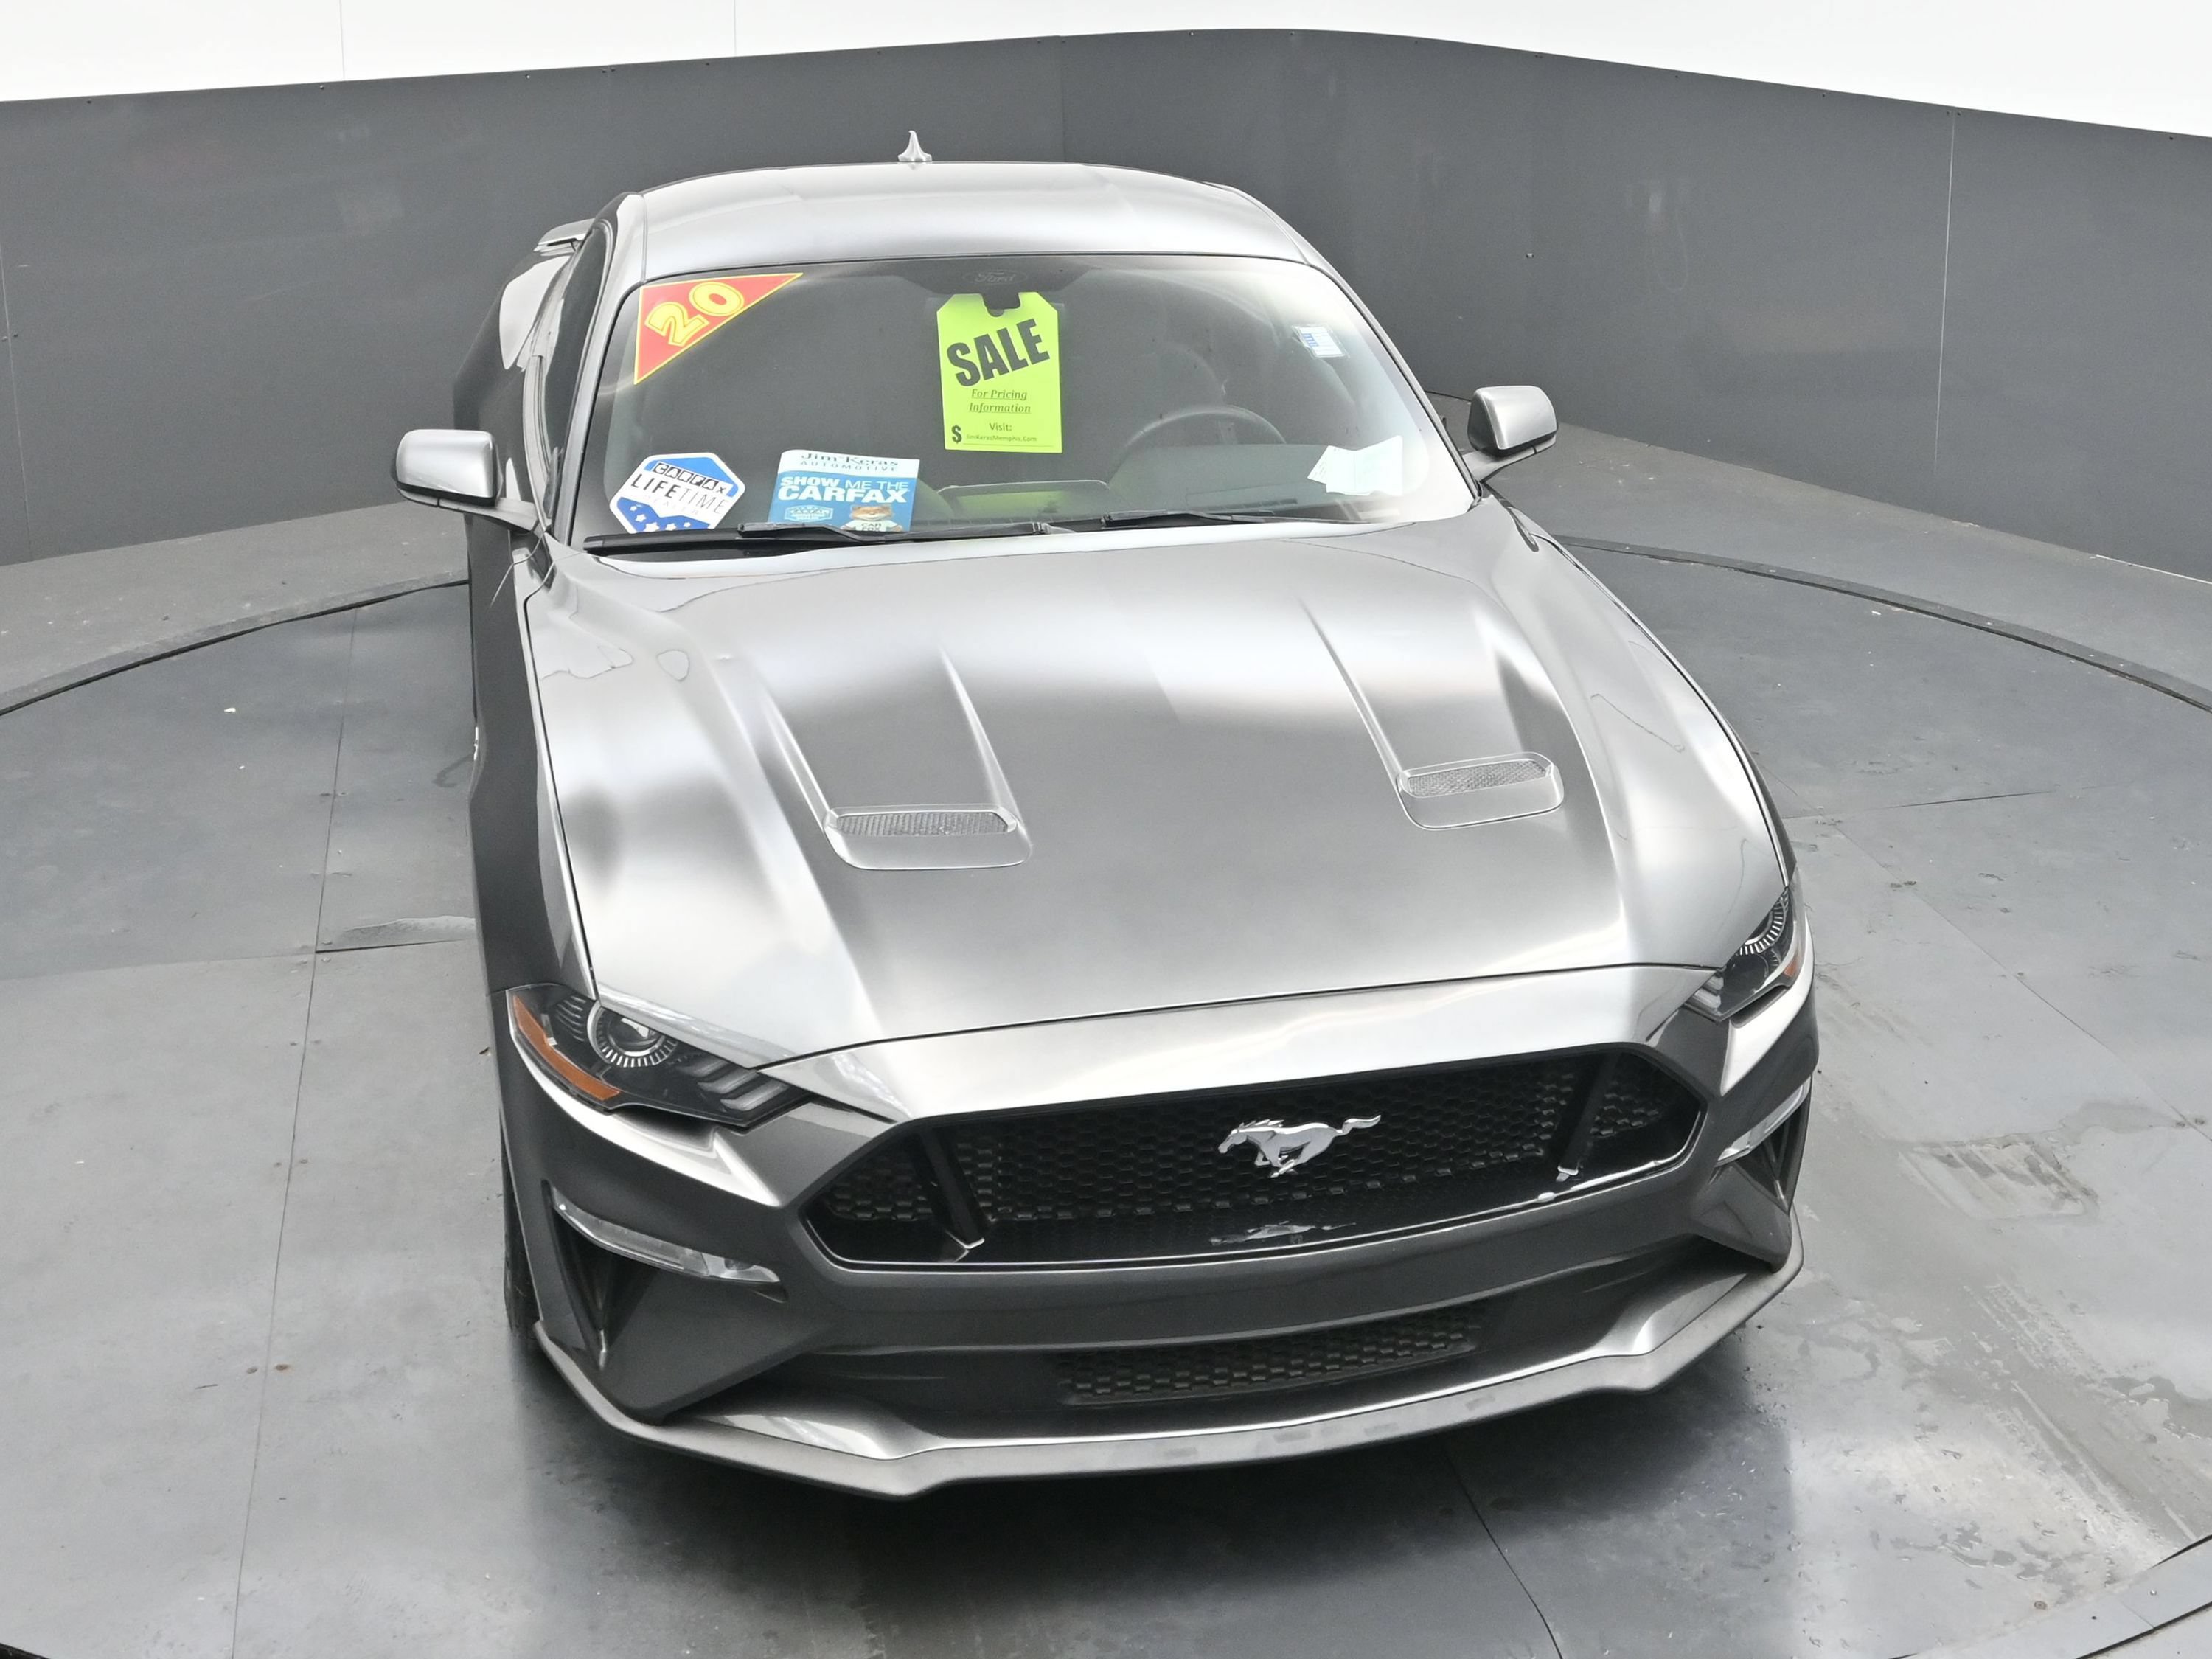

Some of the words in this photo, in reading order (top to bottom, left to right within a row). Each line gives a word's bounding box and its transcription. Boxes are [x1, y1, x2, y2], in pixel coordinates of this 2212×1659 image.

[644, 282, 745, 347] 20
[947, 319, 1050, 386] SALE
[971, 389, 988, 399] For
[990, 389, 1027, 400] Pricing
[969, 403, 1031, 413] Information
[951, 424, 962, 444] $
[989, 422, 1012, 431] Visit:
[801, 453, 837, 462] Jim
[846, 456, 898, 466] Keras
[652, 462, 726, 493] CARFAX
[780, 476, 841, 487] SHOW
[845, 480, 872, 490] ME
[876, 481, 909, 490] THE
[631, 473, 730, 514] LIFETIME
[778, 485, 907, 503] CARFAX
